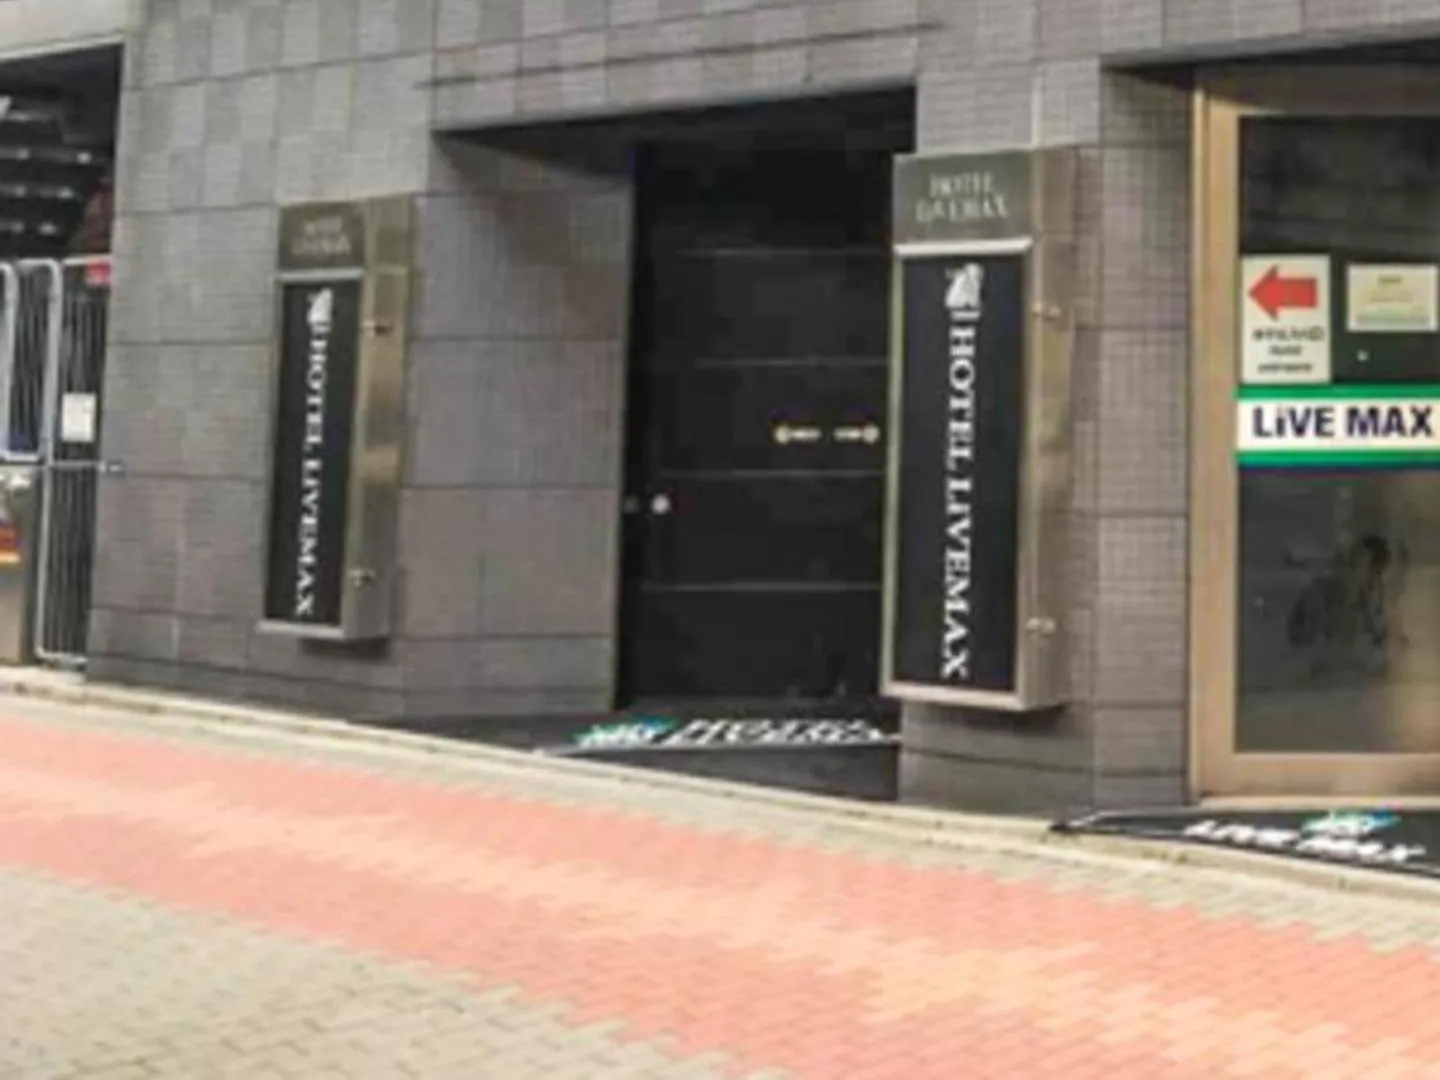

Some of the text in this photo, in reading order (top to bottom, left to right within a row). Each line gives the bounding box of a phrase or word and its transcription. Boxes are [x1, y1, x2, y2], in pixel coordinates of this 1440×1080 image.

[1346, 405, 1433, 439] MAX
[296, 458, 322, 616] LIVEMAX
[940, 326, 976, 680] HOTEL LIVEMAX
